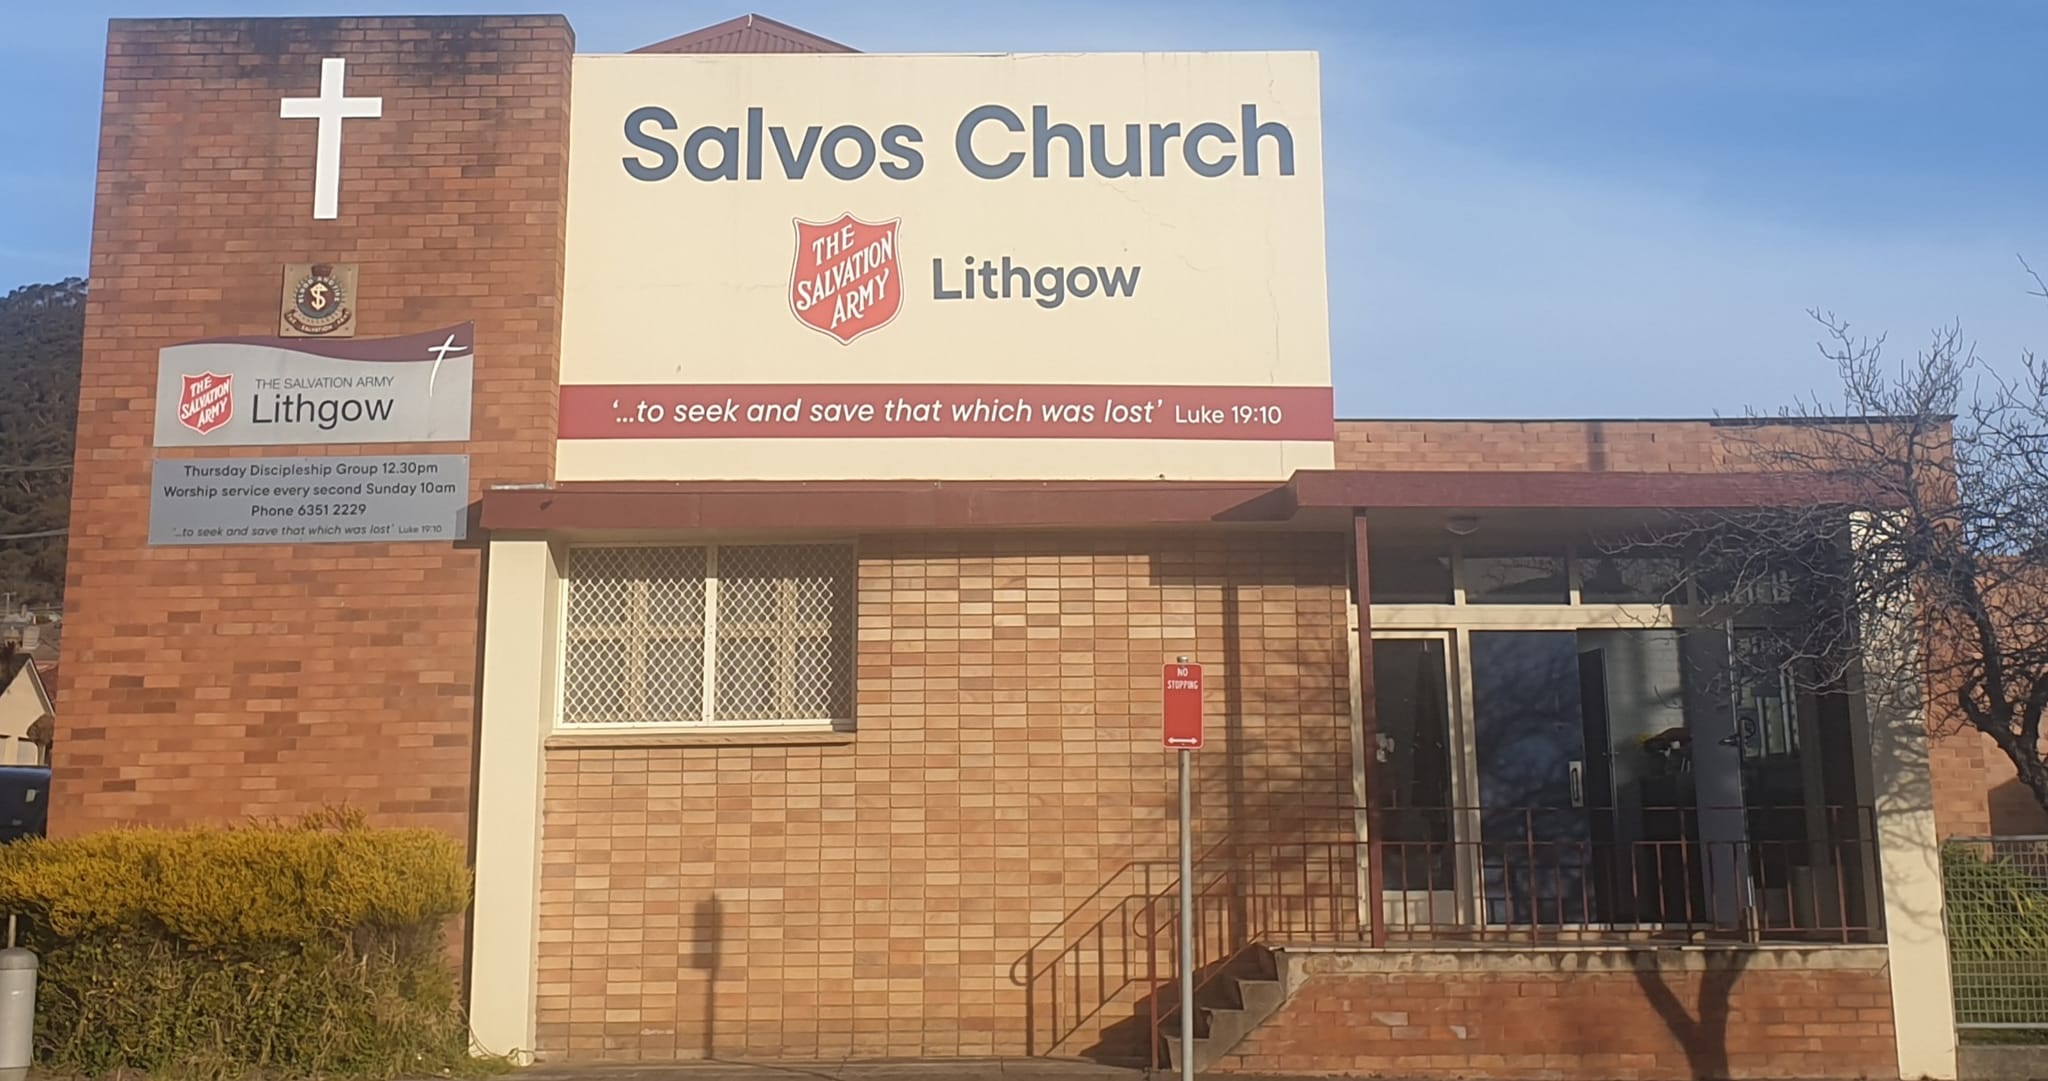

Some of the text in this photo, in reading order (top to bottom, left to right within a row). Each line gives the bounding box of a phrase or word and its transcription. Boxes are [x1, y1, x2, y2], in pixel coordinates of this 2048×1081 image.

[622, 104, 1295, 181] Salvos Church
[812, 223, 855, 266] THE
[796, 230, 892, 311] SALVATION
[932, 256, 1141, 308] Lithgow
[830, 267, 889, 329] ARMY
[190, 376, 212, 398] THE
[255, 376, 394, 390] THE SALVATION ARMY
[181, 378, 230, 420] SALVATION
[197, 396, 228, 428] ARMY
[252, 393, 394, 430] Lithgow
[673, 398, 740, 422] seek
[746, 398, 802, 422] and
[809, 403, 874, 422] save
[884, 398, 942, 422] that
[951, 399, 1032, 422] which
[1041, 403, 1095, 422] was
[1104, 399, 1164, 423] lost’
[1175, 405, 1225, 423] Luke
[1231, 405, 1282, 424] 19:10
[184, 462, 438, 478] Thursday Discipleship Group 12.30pm
[164, 482, 456, 499] Worship service every second Sunday 10am
[251, 503, 367, 516] Phone 6351 2229
[197, 526, 223, 536] seek
[226, 526, 249, 536] and
[251, 527, 278, 536] save
[281, 526, 305, 536] that
[308, 525, 342, 535] which
[345, 526, 366, 535] was
[398, 525, 418, 534] Luke
[1167, 680, 1198, 689] STOPPING
[1177, 667, 1189, 677] NO
